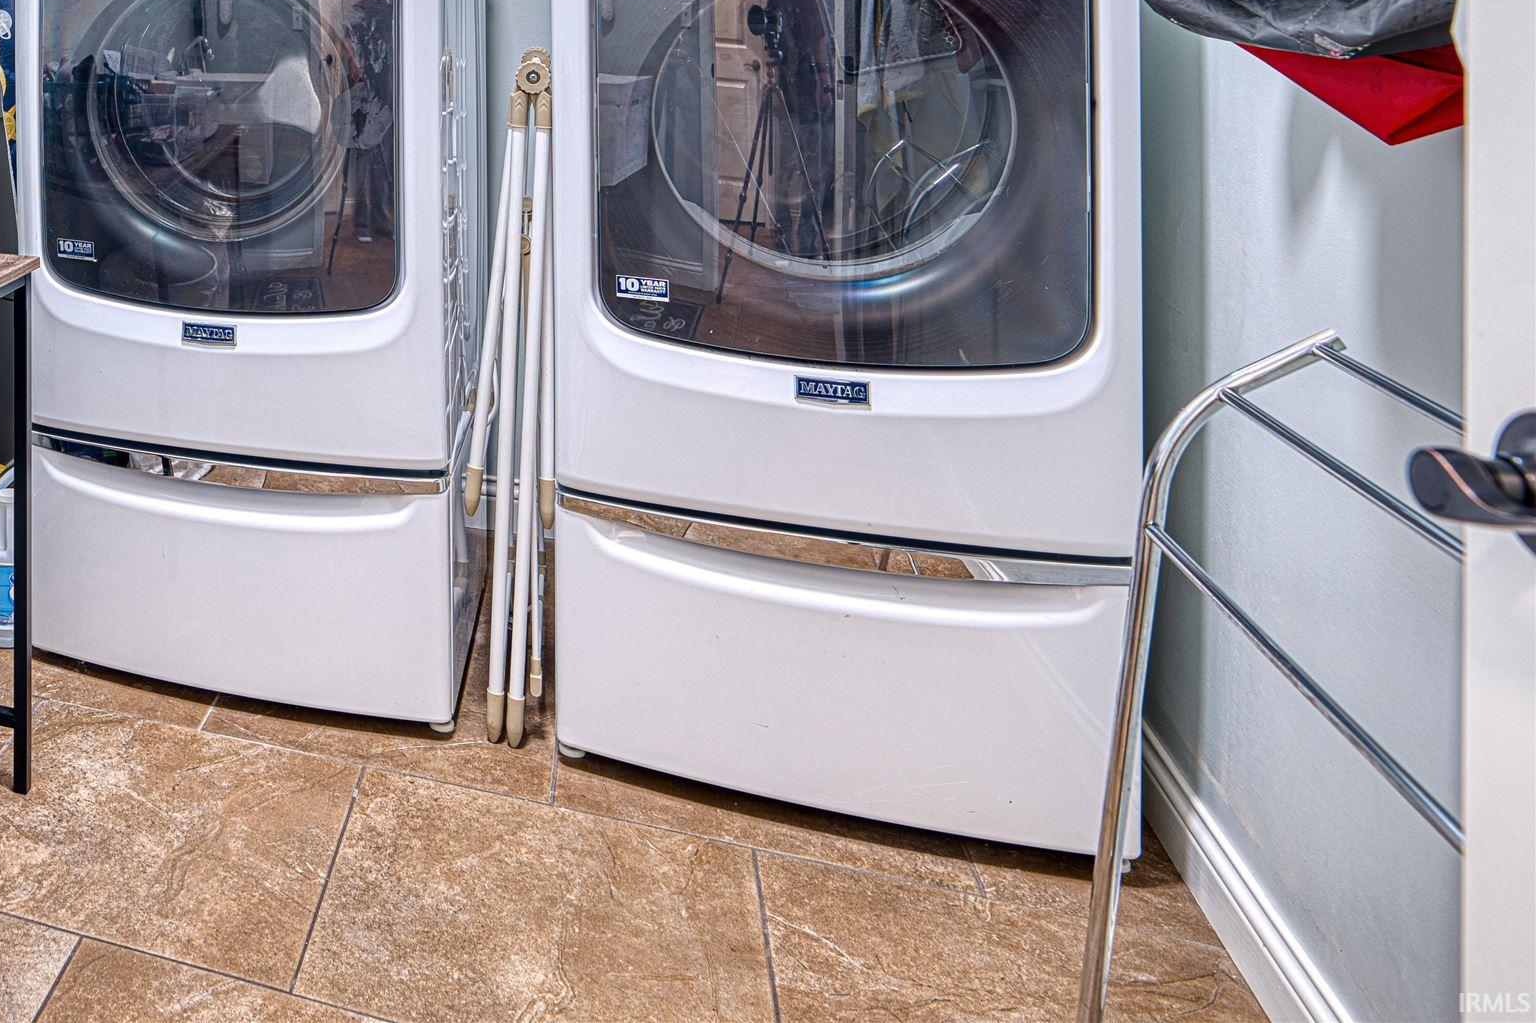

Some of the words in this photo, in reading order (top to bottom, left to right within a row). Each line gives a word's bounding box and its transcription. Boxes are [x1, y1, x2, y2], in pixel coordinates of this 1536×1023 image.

[58, 240, 74, 253] 10
[619, 278, 639, 291] 10
[185, 326, 233, 340] MAYTAG
[799, 381, 866, 399] MAYTAG
